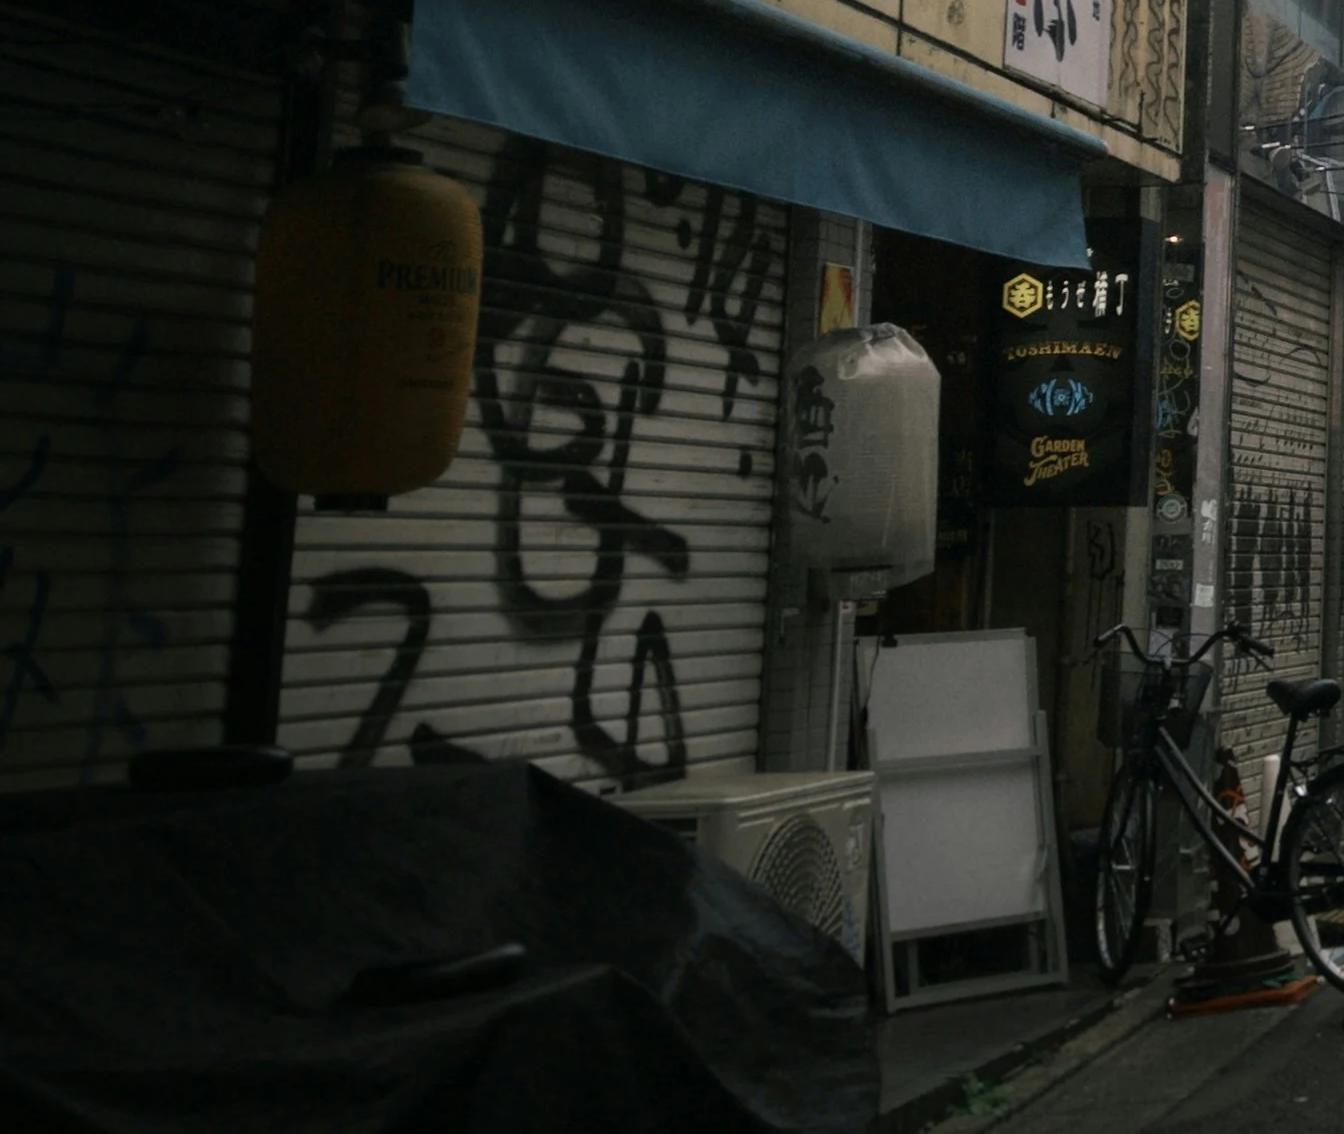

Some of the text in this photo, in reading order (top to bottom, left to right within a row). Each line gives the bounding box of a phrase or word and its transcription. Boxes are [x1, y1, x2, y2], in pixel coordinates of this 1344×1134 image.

[1003, 340, 1124, 362] TOSHIMAEN
[1030, 435, 1088, 459] GARDEN
[1023, 452, 1089, 487] THEATER
